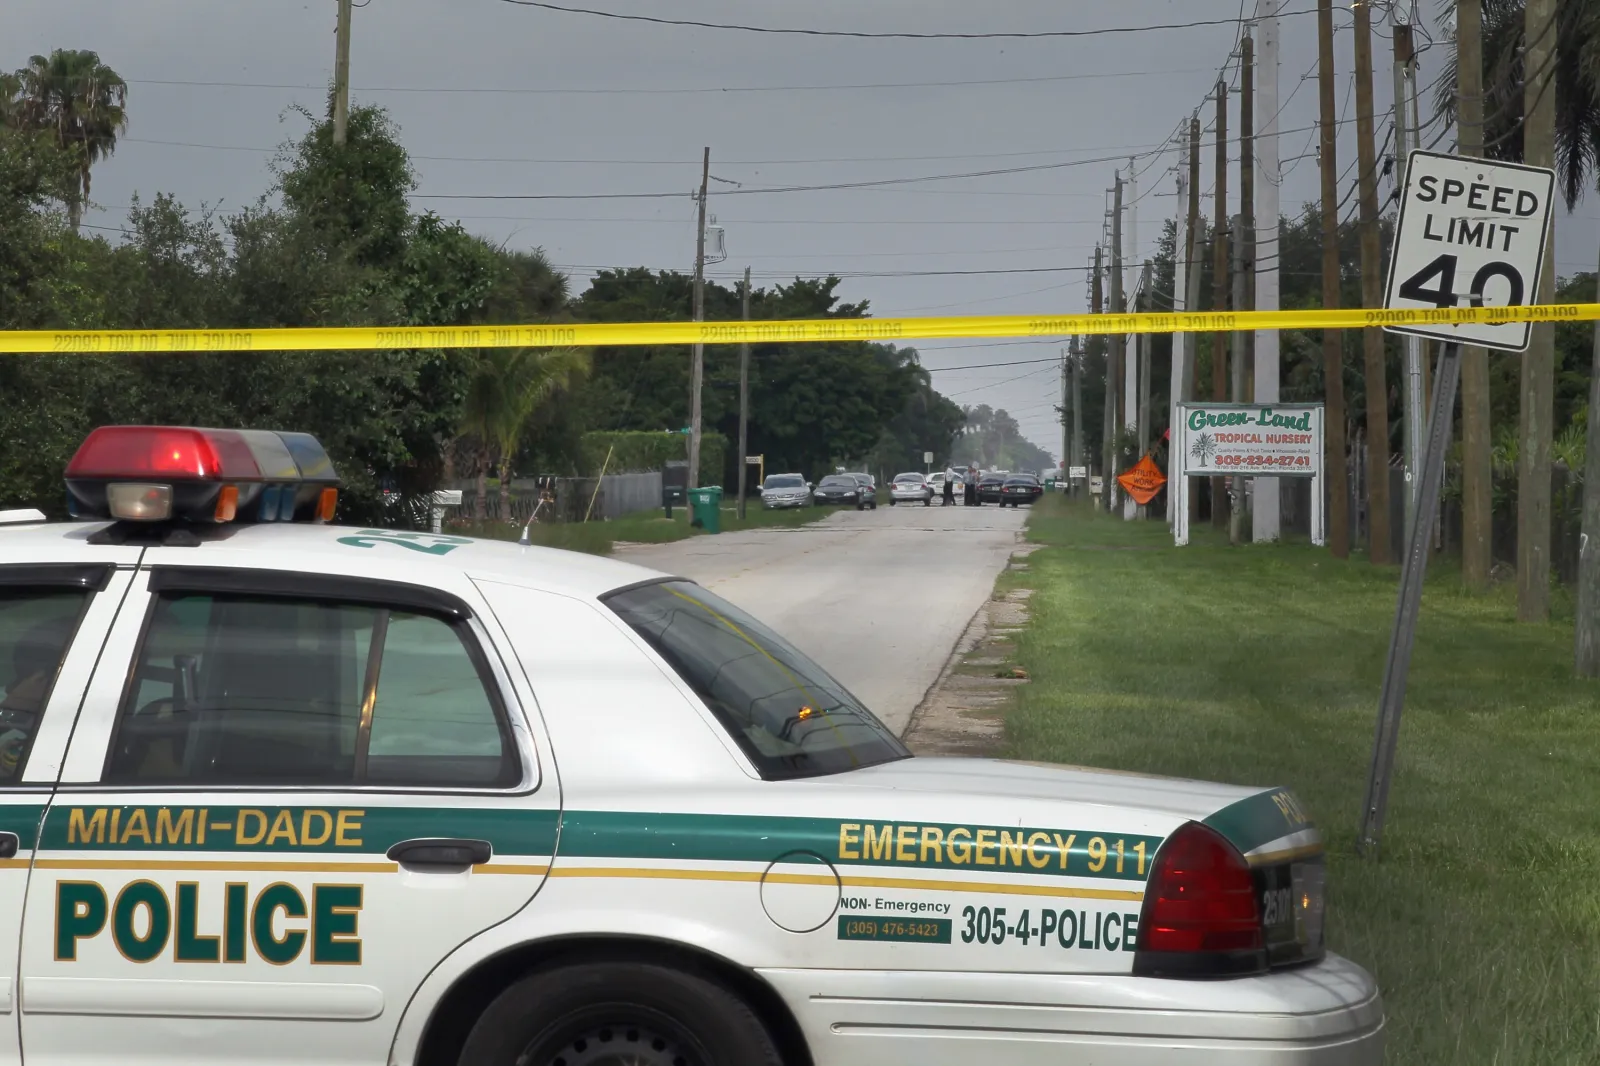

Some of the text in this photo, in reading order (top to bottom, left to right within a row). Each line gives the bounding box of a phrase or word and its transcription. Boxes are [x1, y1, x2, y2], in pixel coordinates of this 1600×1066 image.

[1415, 175, 1539, 217] SPEED
[1423, 214, 1520, 252] LIMIT
[1398, 253, 1524, 327] 40
[1188, 407, 1312, 432] Green-Land
[1214, 433, 1312, 445] TROPICAL NURSERY
[67, 807, 366, 848] MIAMI-DADE
[838, 823, 1147, 875] EMERGENCY 911
[53, 878, 364, 966] POLICE
[840, 897, 951, 915] NON- Emergency
[846, 921, 939, 938] (305) 476-5423
[960, 904, 1139, 953] 305-4-POLICE
